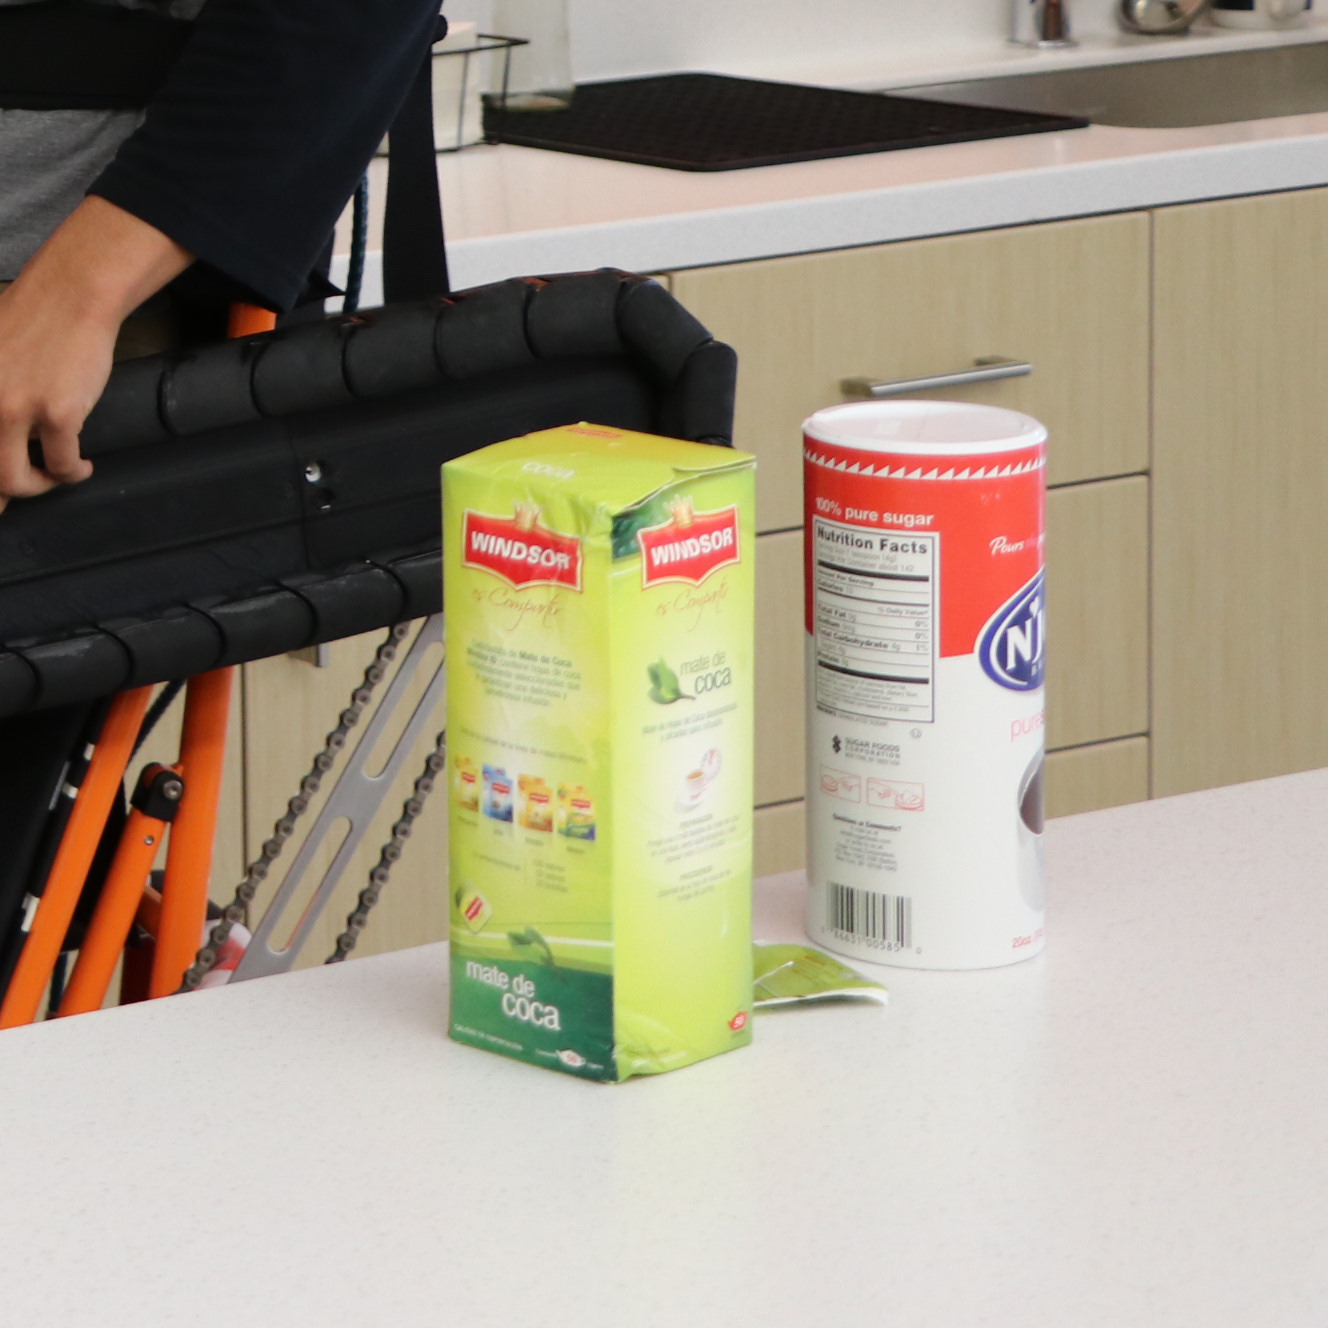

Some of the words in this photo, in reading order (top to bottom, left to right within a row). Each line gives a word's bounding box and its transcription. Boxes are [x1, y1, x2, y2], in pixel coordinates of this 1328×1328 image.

[816, 497, 842, 515] 100%
[845, 507, 879, 521] pure
[883, 512, 934, 528] sugar
[471, 531, 570, 570] WINDSOR
[651, 527, 734, 568] WINDSOR
[817, 526, 873, 550] Nutrition
[880, 539, 927, 554] Facts
[989, 535, 1025, 556] Pours
[680, 655, 710, 677] mate
[711, 649, 726, 666] de
[694, 667, 732, 695] coca
[845, 737, 870, 749] SUGAR
[871, 742, 900, 753] FOODS
[466, 961, 509, 990] mate
[512, 975, 535, 998] de
[502, 992, 561, 1031] coca
